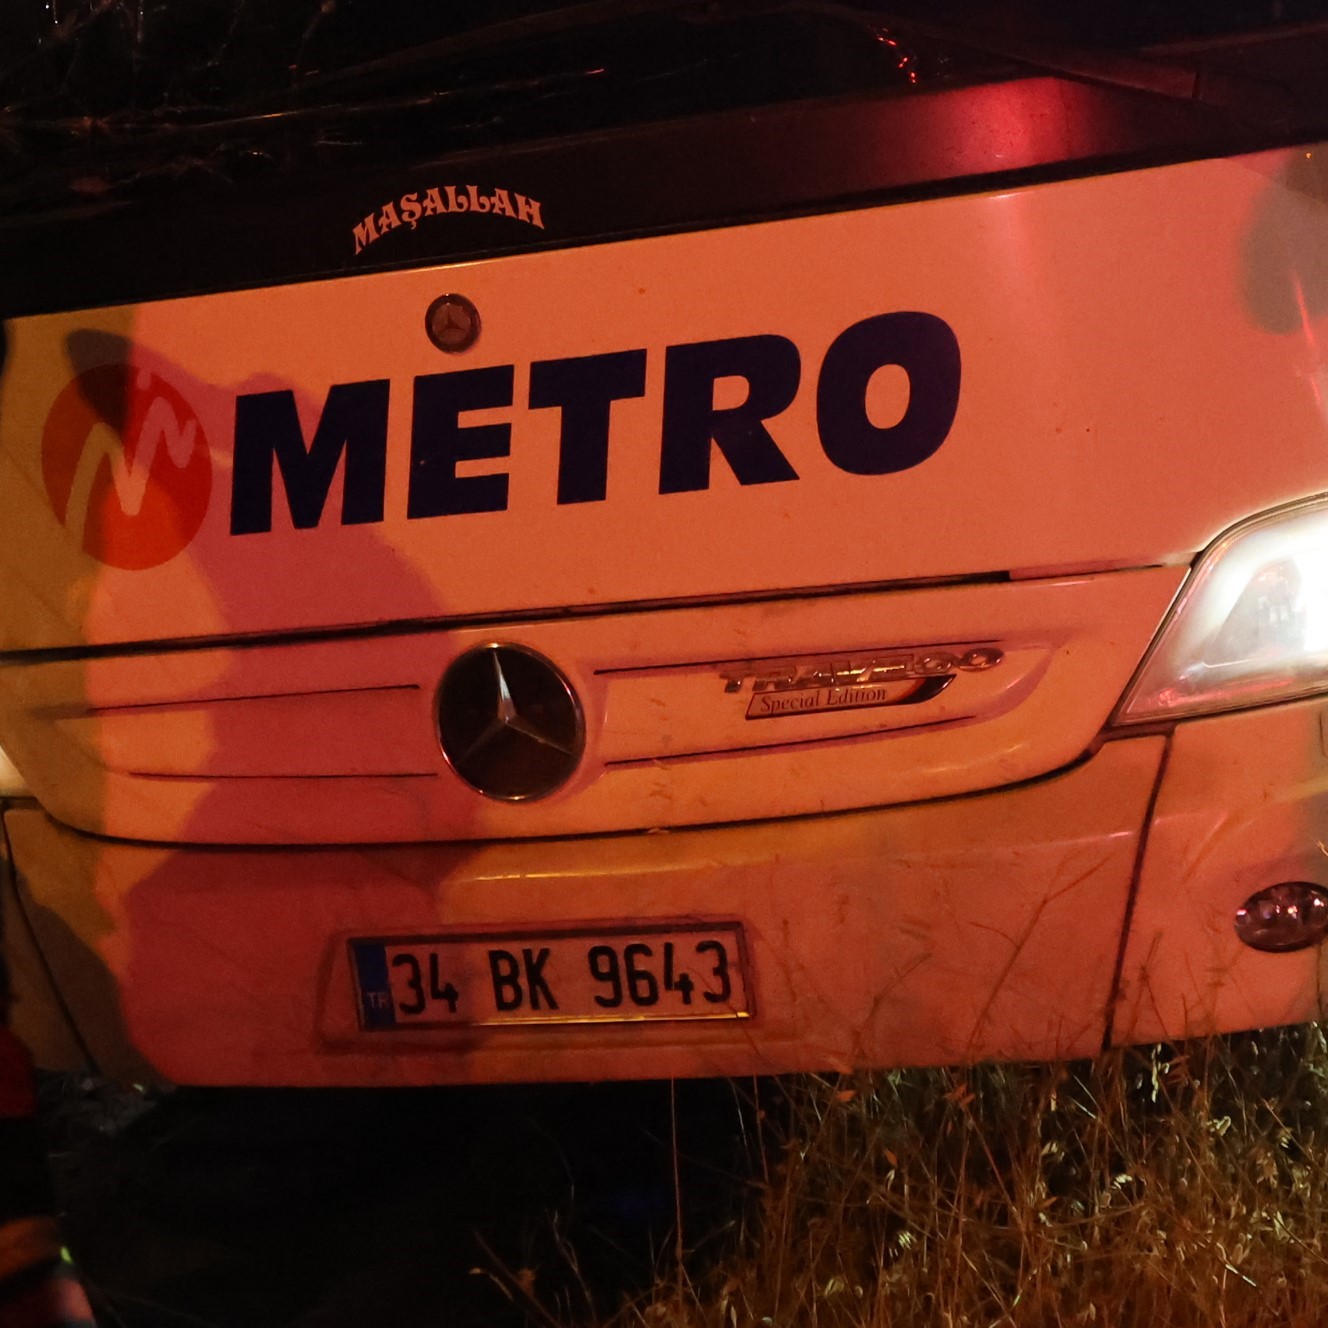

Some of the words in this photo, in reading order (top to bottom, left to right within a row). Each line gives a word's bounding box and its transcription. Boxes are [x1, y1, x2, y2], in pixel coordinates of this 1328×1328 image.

[351, 184, 545, 256] MAŞALLAH
[229, 310, 962, 536] METRO
[759, 688, 821, 713] Special
[825, 681, 887, 707] Edition
[390, 952, 460, 1015] 34
[488, 947, 560, 1012] BK
[587, 939, 732, 1008] 9643
